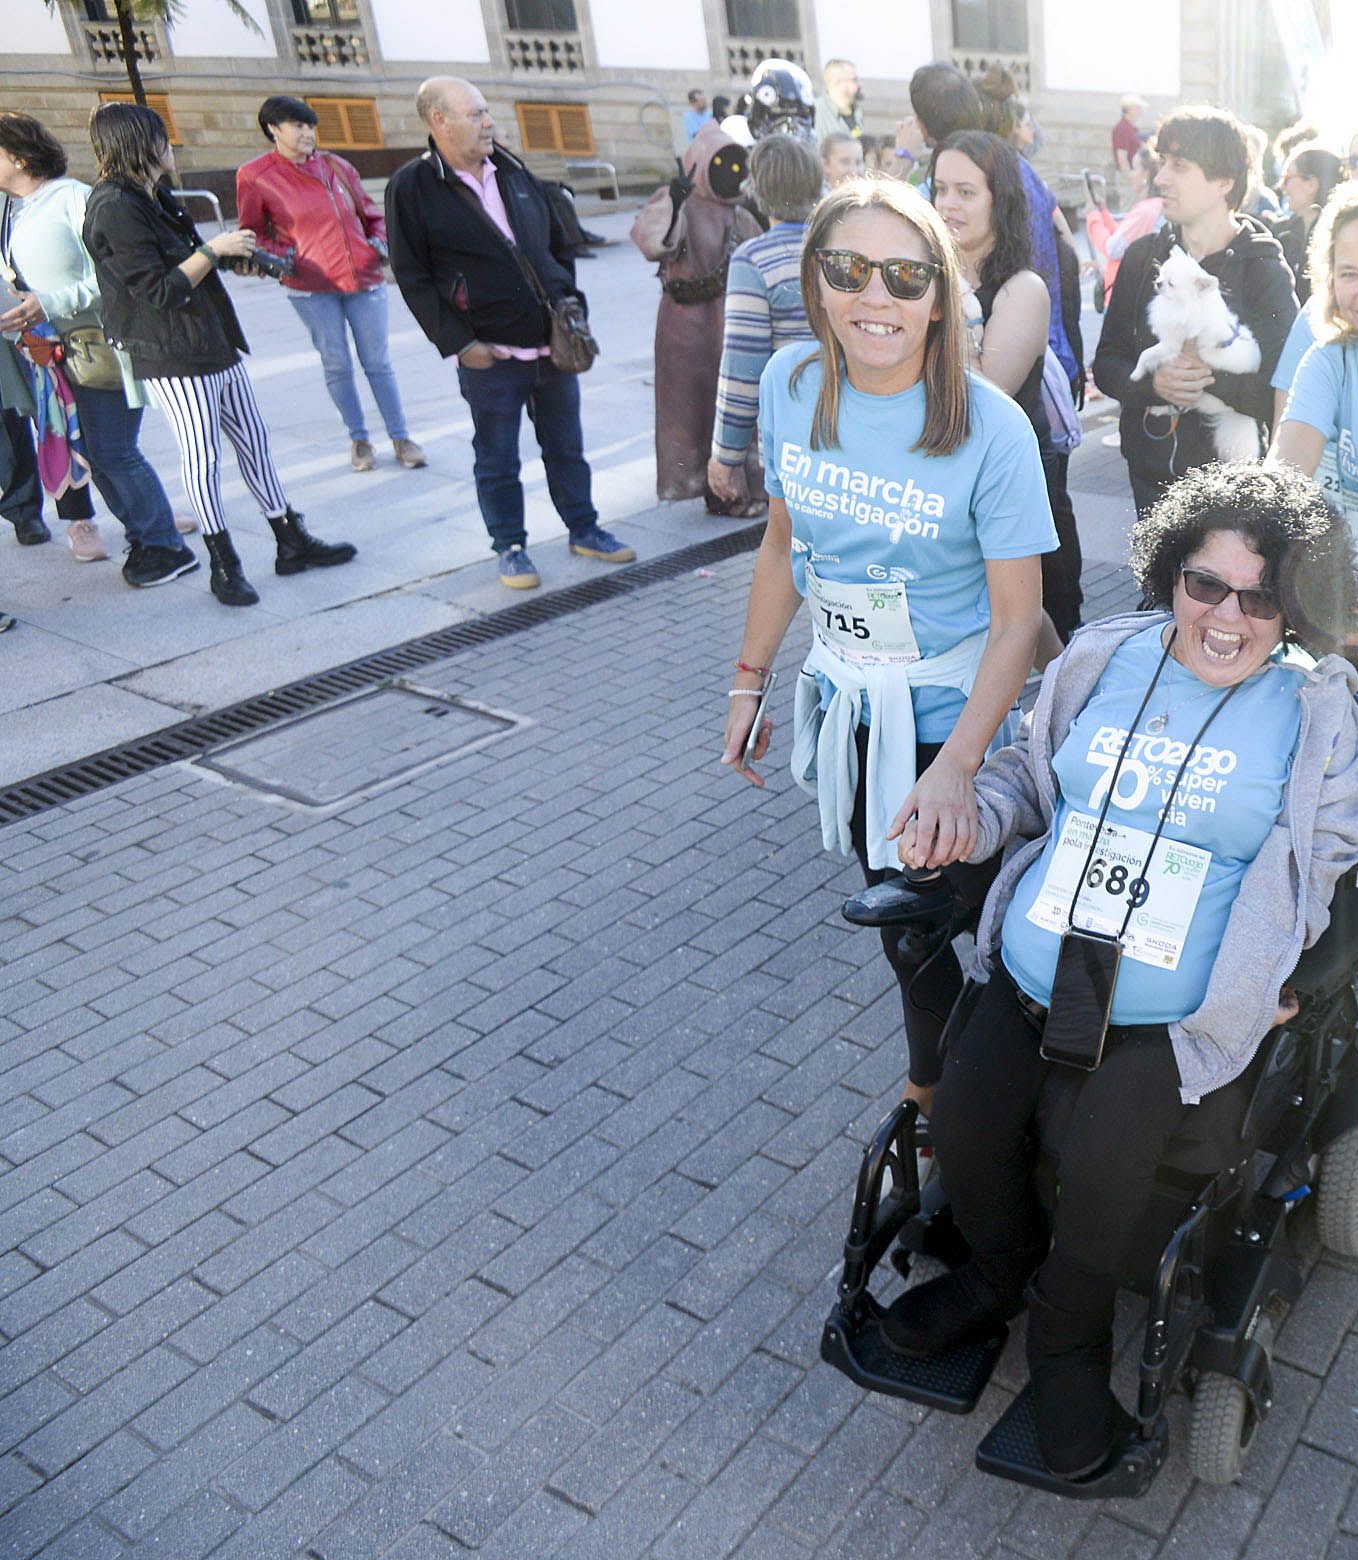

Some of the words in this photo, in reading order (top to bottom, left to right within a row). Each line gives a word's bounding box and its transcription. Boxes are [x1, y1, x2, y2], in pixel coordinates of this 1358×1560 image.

[780, 441, 812, 479] En
[816, 460, 945, 518] marcha
[801, 505, 834, 520] cancro
[821, 606, 871, 640] 715
[1089, 726, 1237, 776] RETO2030
[1164, 770, 1228, 794] super
[1161, 788, 1217, 813] viven
[1157, 806, 1188, 828] cia
[1086, 859, 1151, 908] 689
